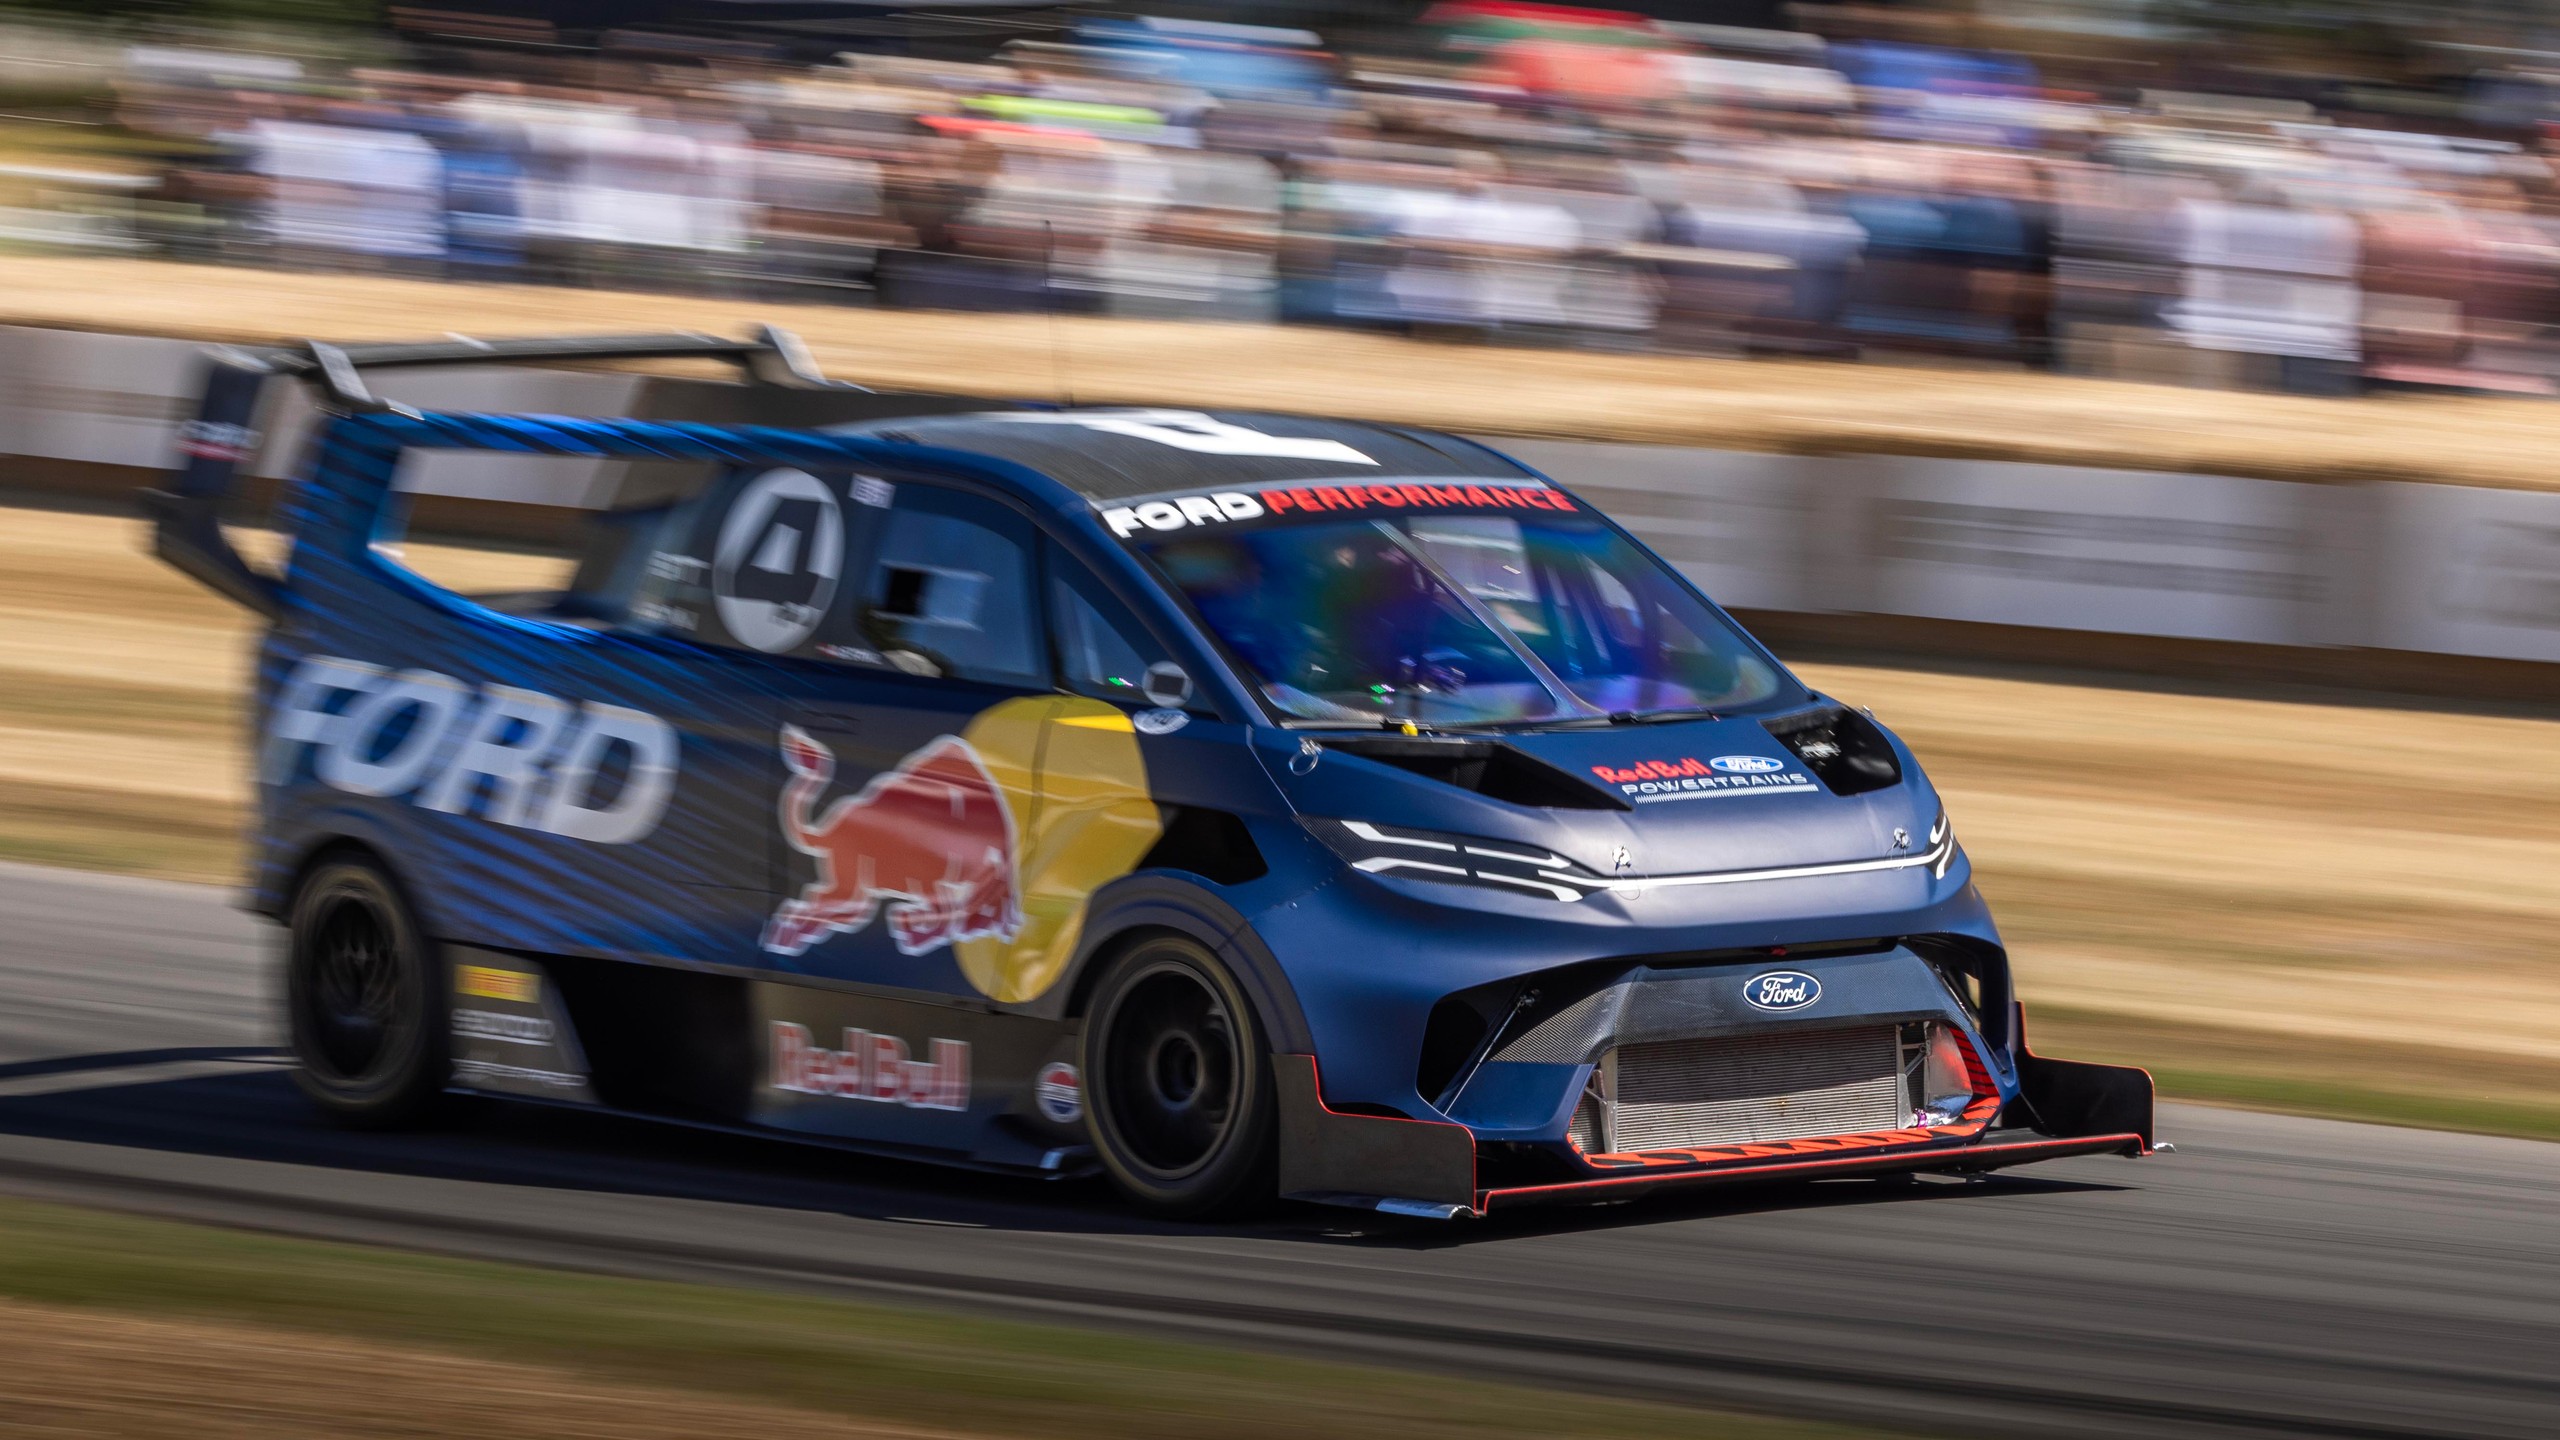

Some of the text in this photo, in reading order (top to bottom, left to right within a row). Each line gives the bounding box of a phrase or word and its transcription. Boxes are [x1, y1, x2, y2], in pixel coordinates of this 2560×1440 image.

[1100, 485, 1579, 538] FORD PERFORMANCE
[724, 495, 832, 606] 4
[262, 654, 680, 845] FORD
[1592, 761, 1662, 784] Red
[1647, 757, 1712, 778] Bull
[1621, 773, 1807, 795] POWERTRAINS
[1759, 977, 1807, 1004] Ford
[769, 1020, 971, 1112] Red Bull
